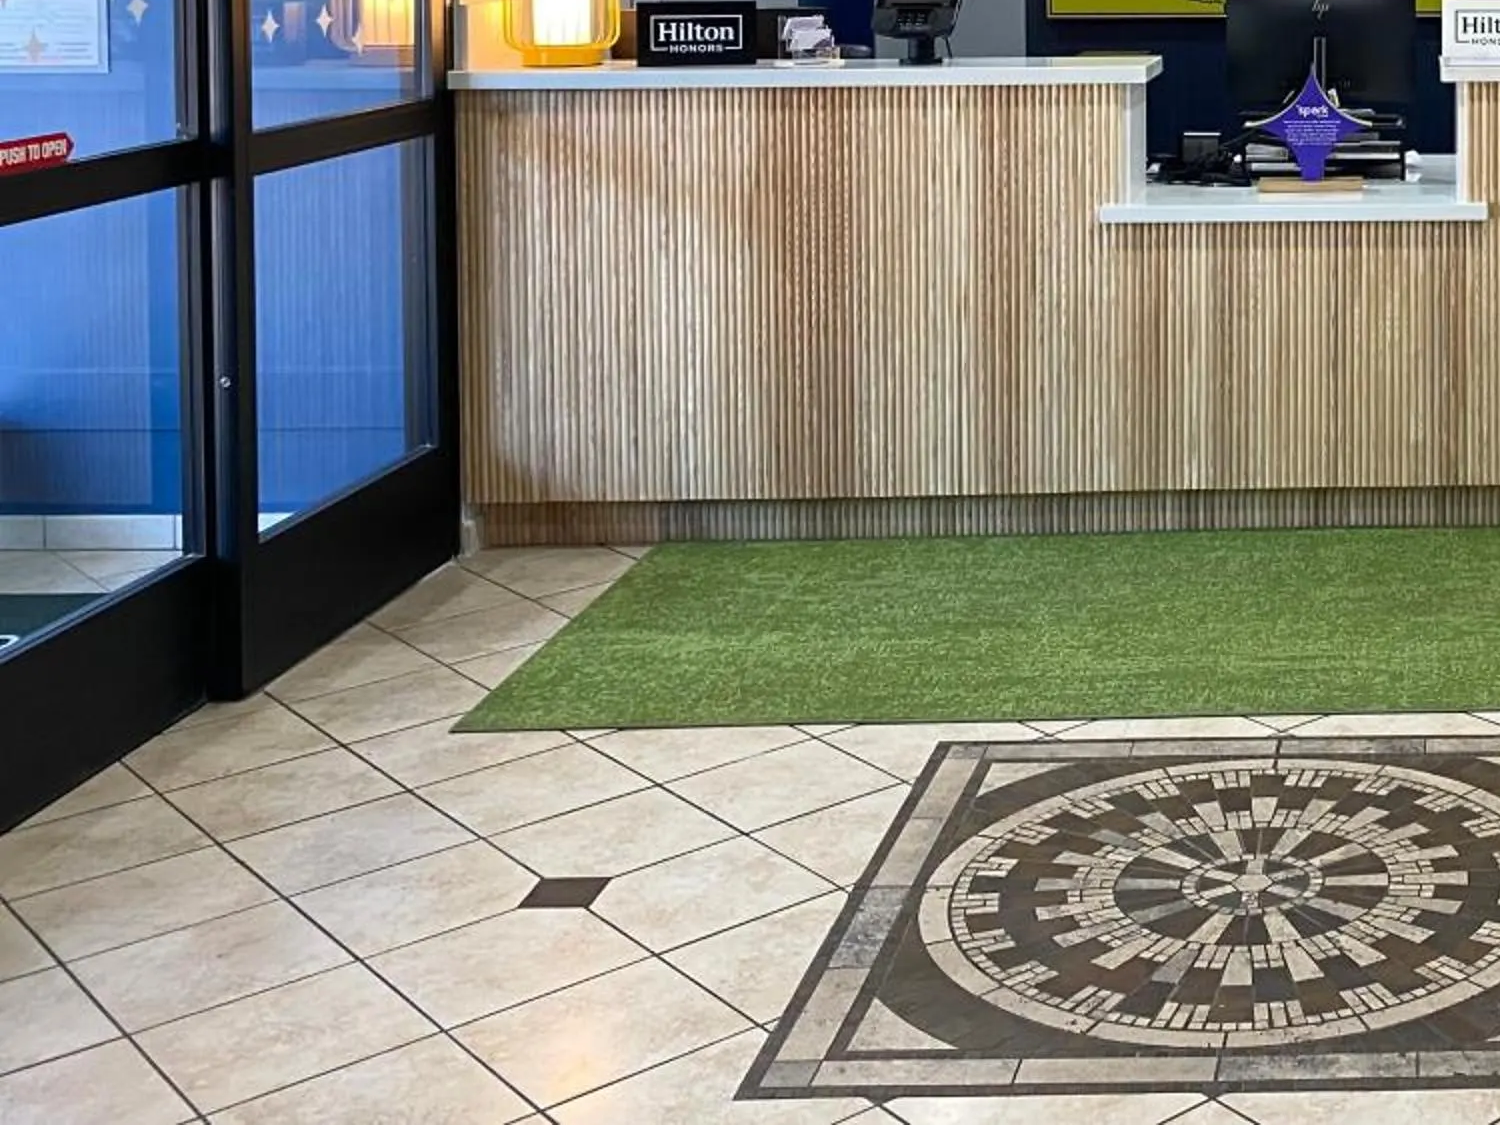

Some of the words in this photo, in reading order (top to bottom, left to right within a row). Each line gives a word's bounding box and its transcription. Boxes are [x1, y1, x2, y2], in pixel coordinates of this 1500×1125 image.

[658, 21, 735, 42] Hilton
[669, 43, 724, 54] HONORS
[0, 146, 26, 166] PUSH
[27, 143, 40, 161] TO
[42, 138, 67, 158] OPEN
